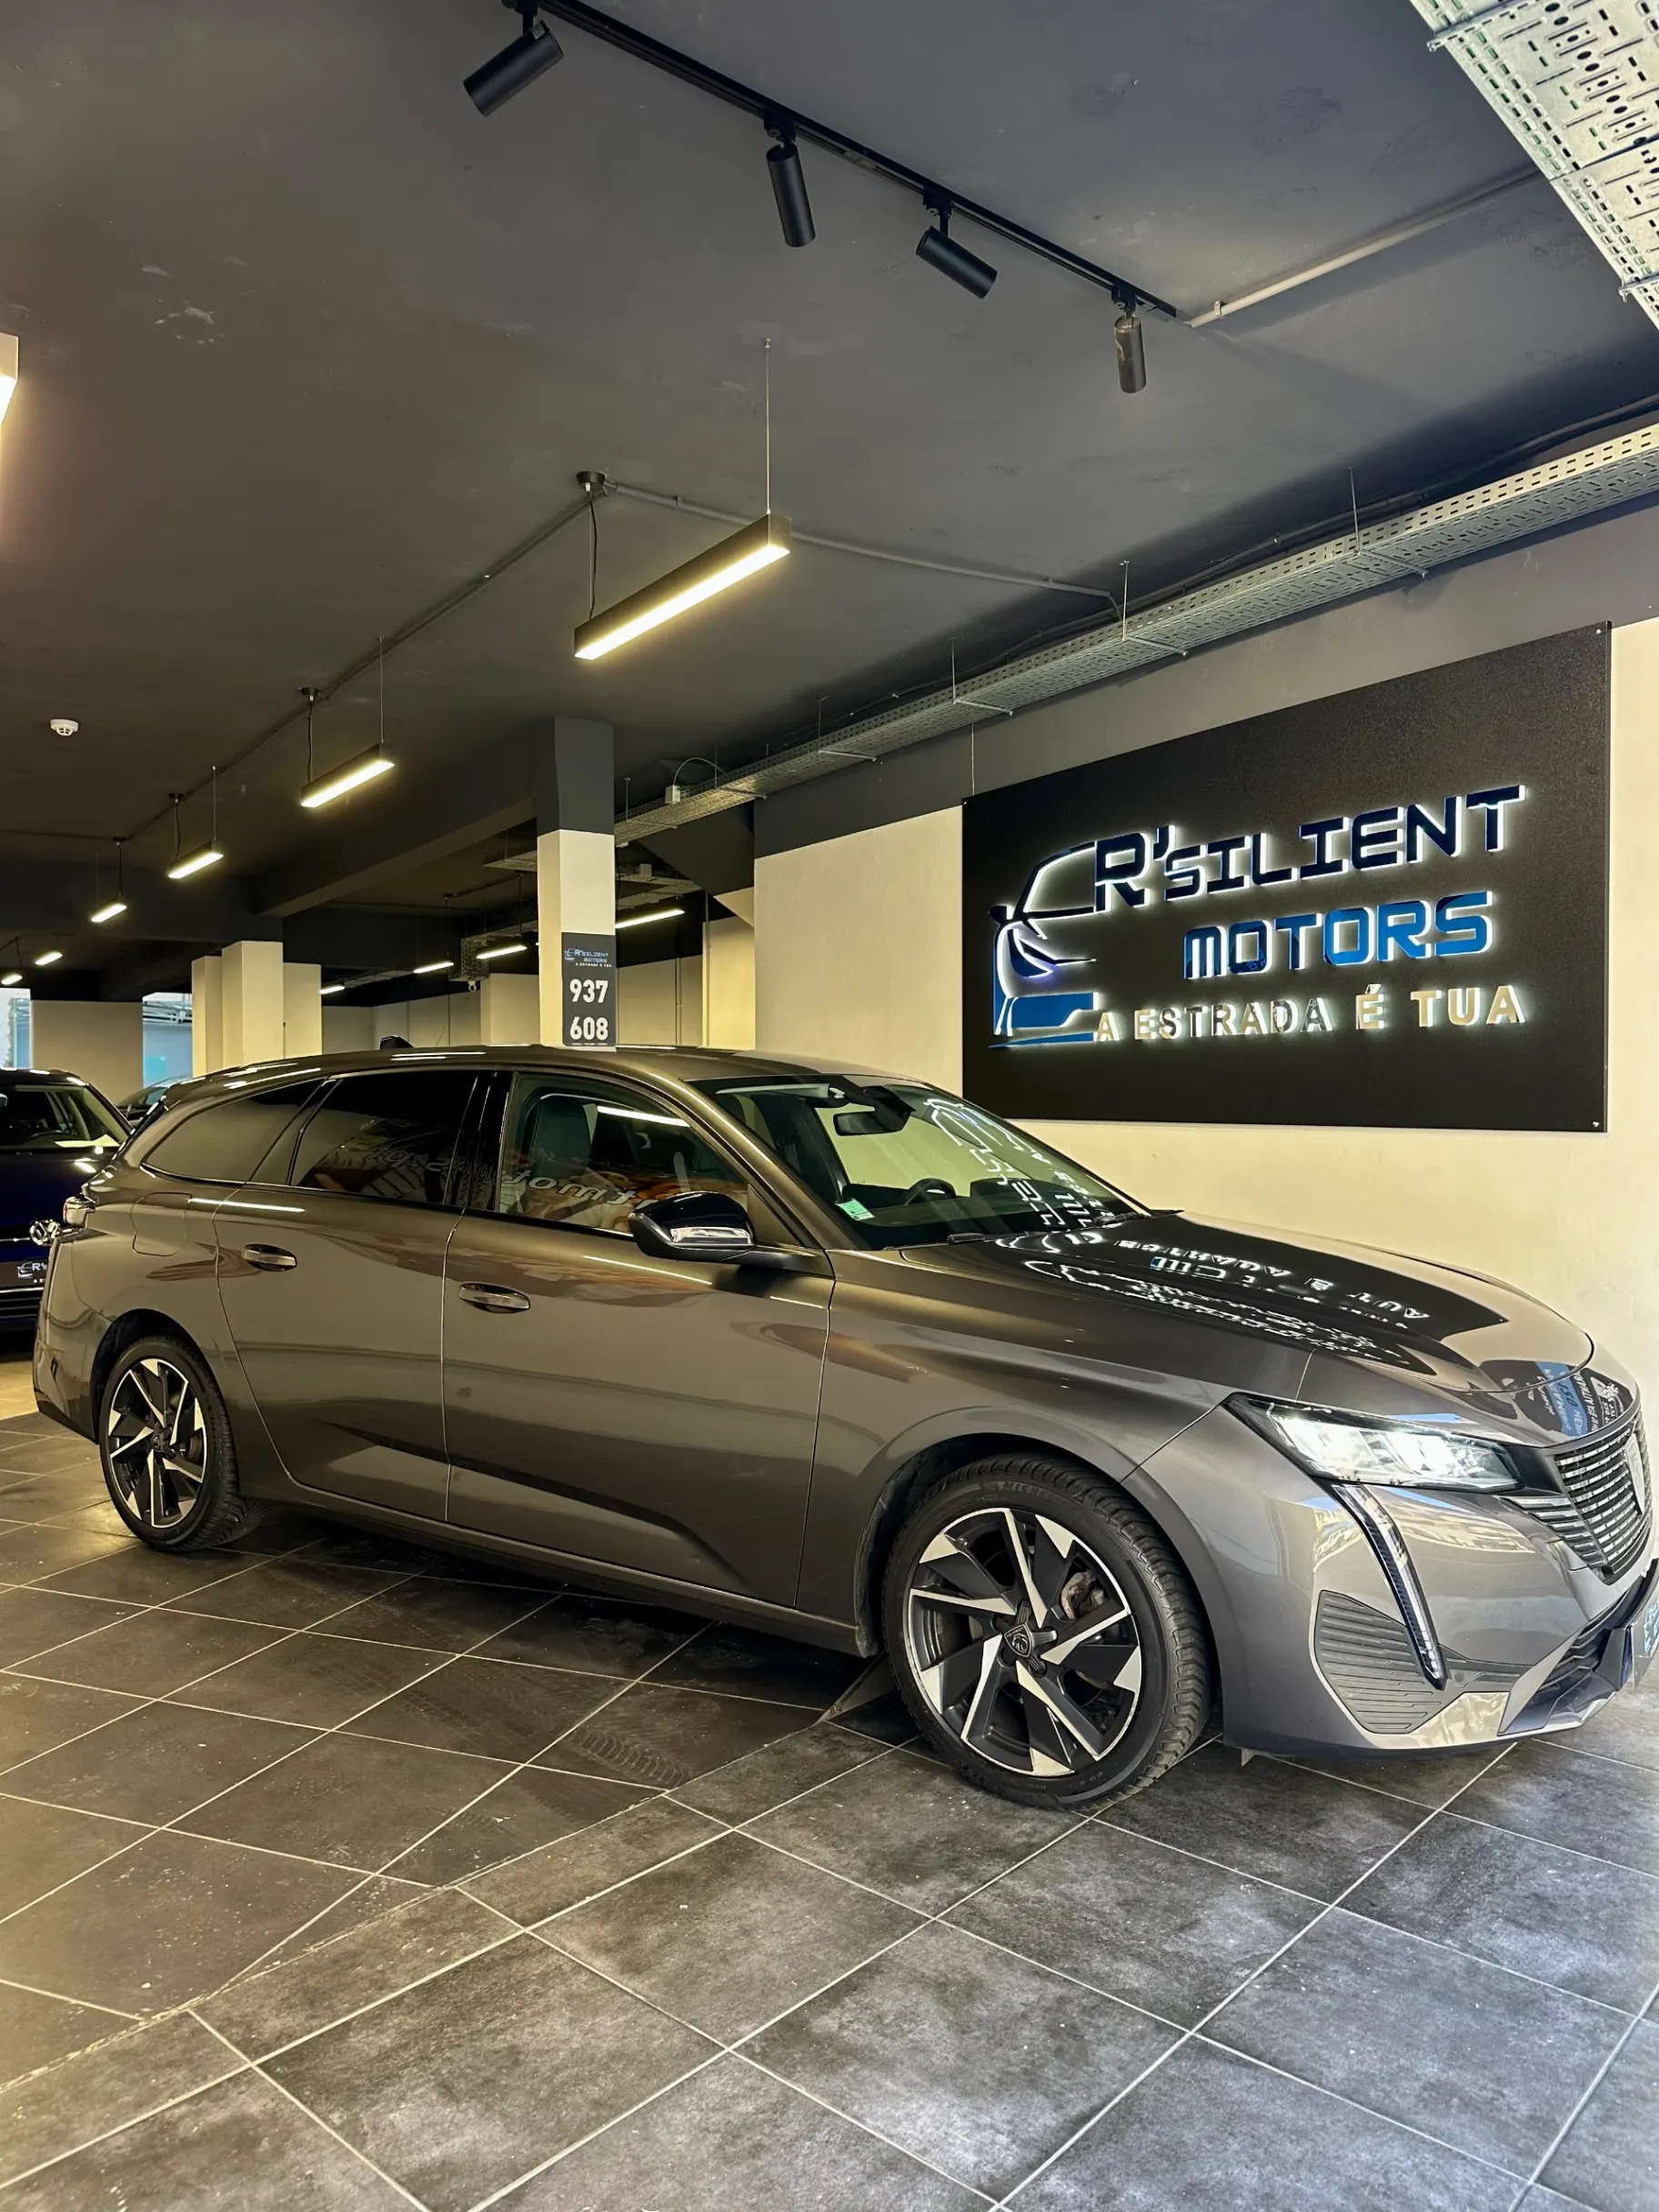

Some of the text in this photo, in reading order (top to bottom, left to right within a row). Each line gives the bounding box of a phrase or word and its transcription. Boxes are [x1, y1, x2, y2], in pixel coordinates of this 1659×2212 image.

[1094, 784, 1525, 912] R'SILIENT
[1183, 890, 1493, 980] MOTORS
[569, 978, 608, 1003] 937
[1094, 983, 1526, 1041] A ESTRADA É TUA
[569, 1016, 608, 1041] 608
